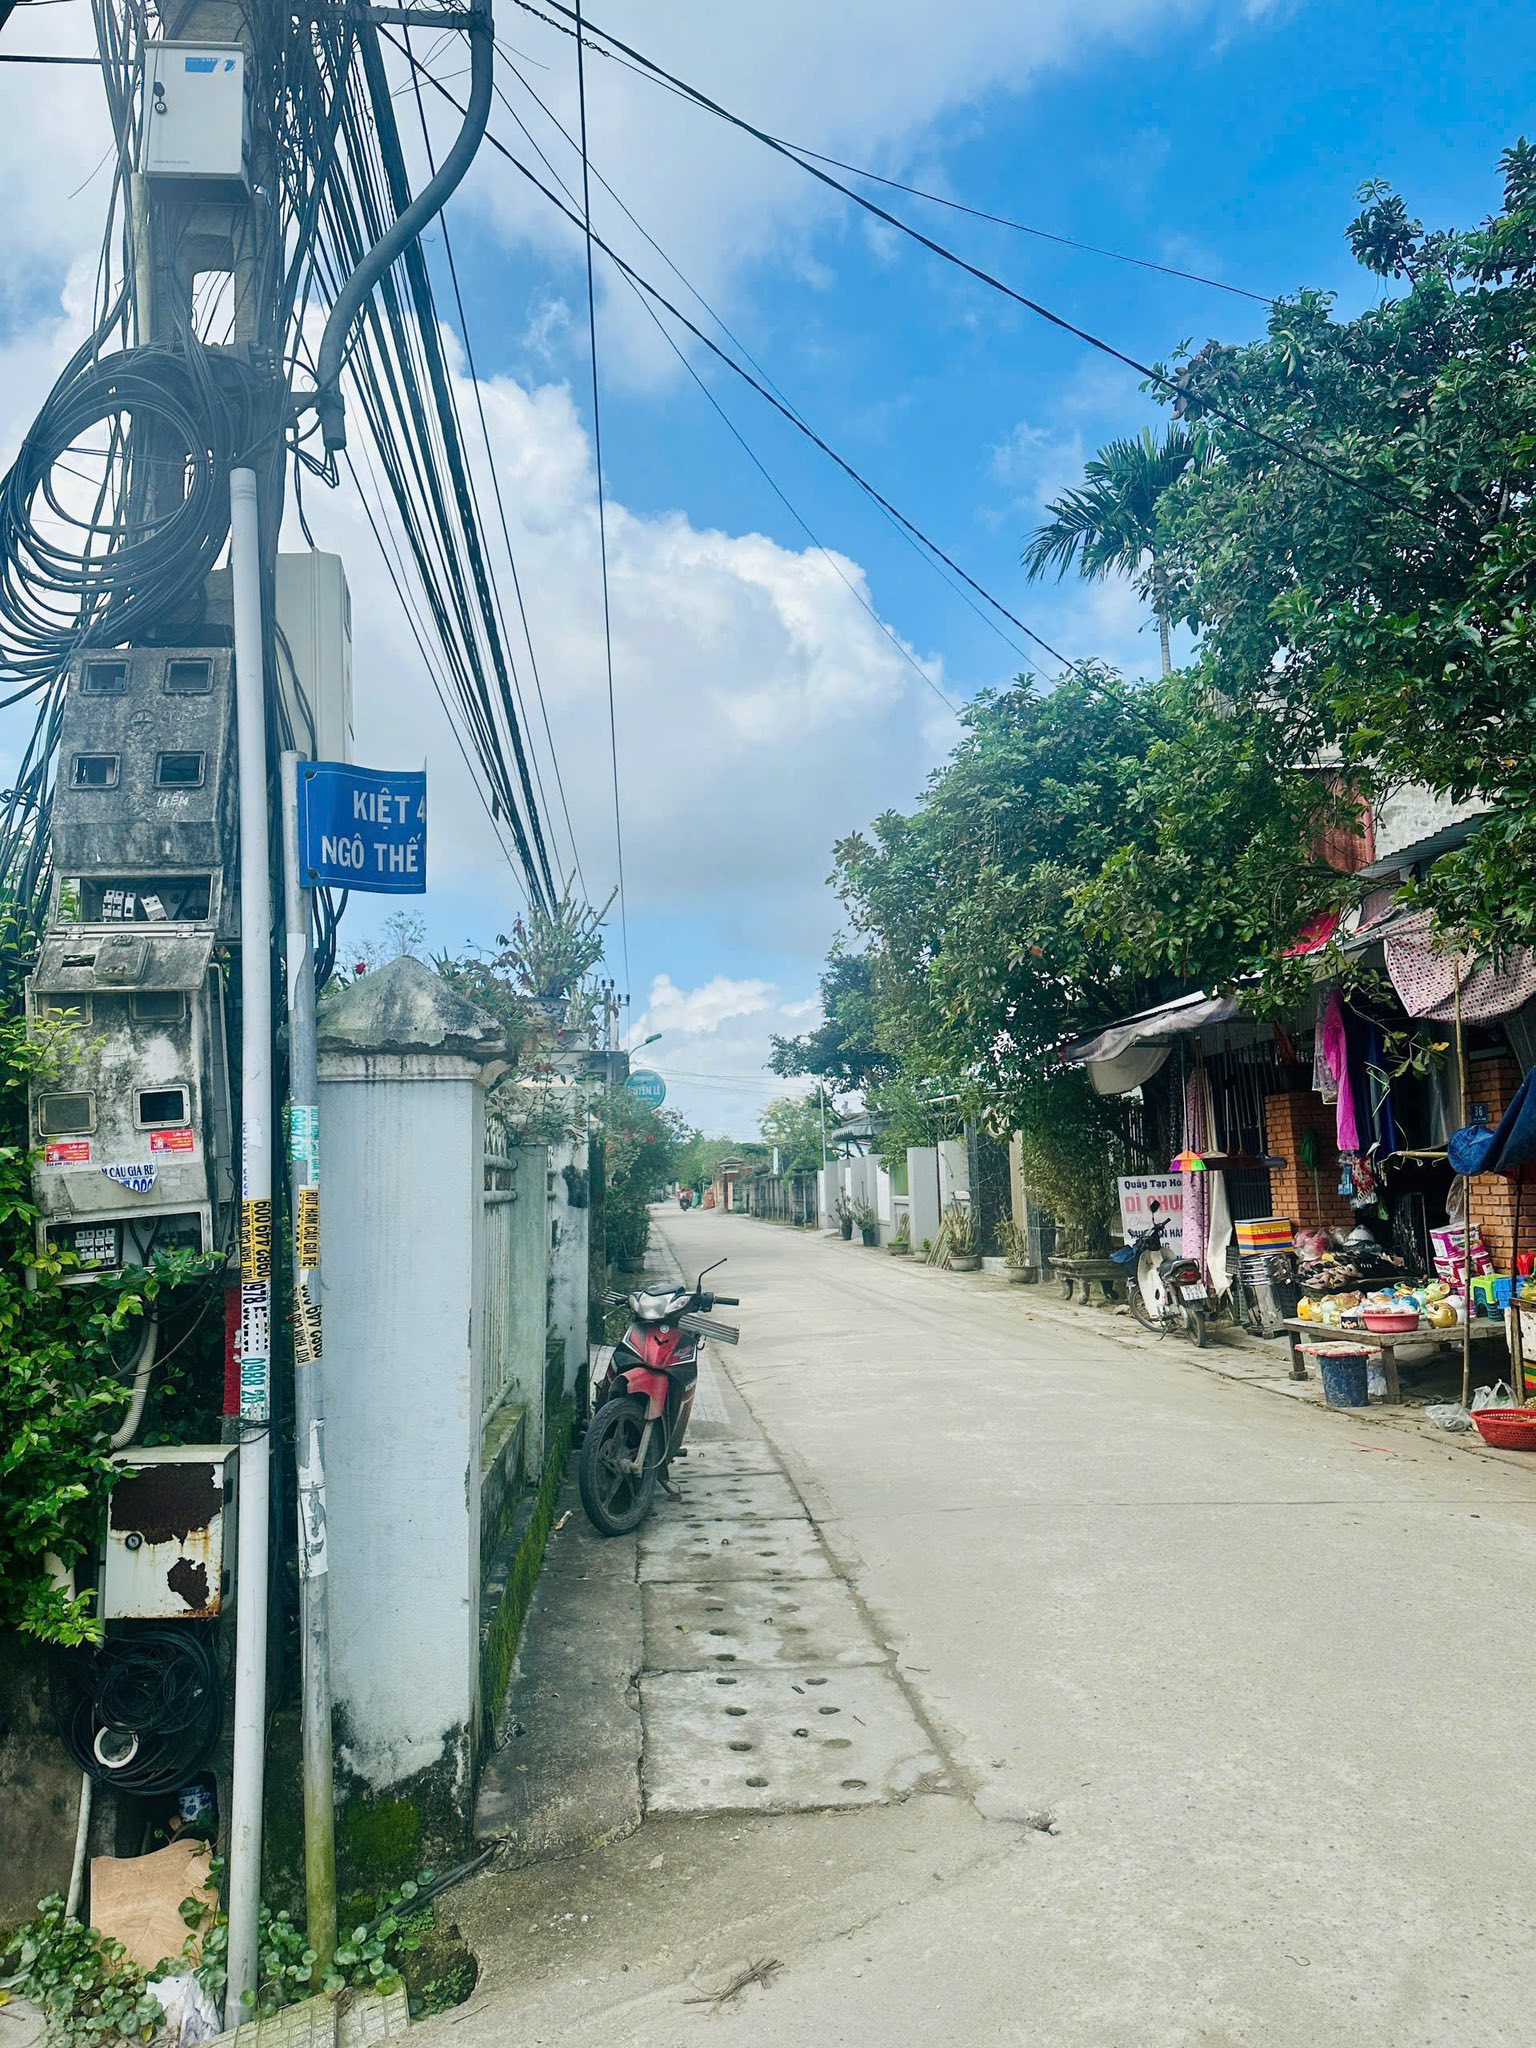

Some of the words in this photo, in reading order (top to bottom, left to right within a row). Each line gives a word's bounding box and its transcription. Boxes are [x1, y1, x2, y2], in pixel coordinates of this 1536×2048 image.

[353, 787, 410, 830] KIỆT
[321, 833, 365, 869] NGÔ
[373, 833, 422, 873] THẾ
[1473, 1106, 1483, 1117] 36
[1150, 1179, 1167, 1189] Tạp
[1146, 1195, 1183, 1211] CHU
